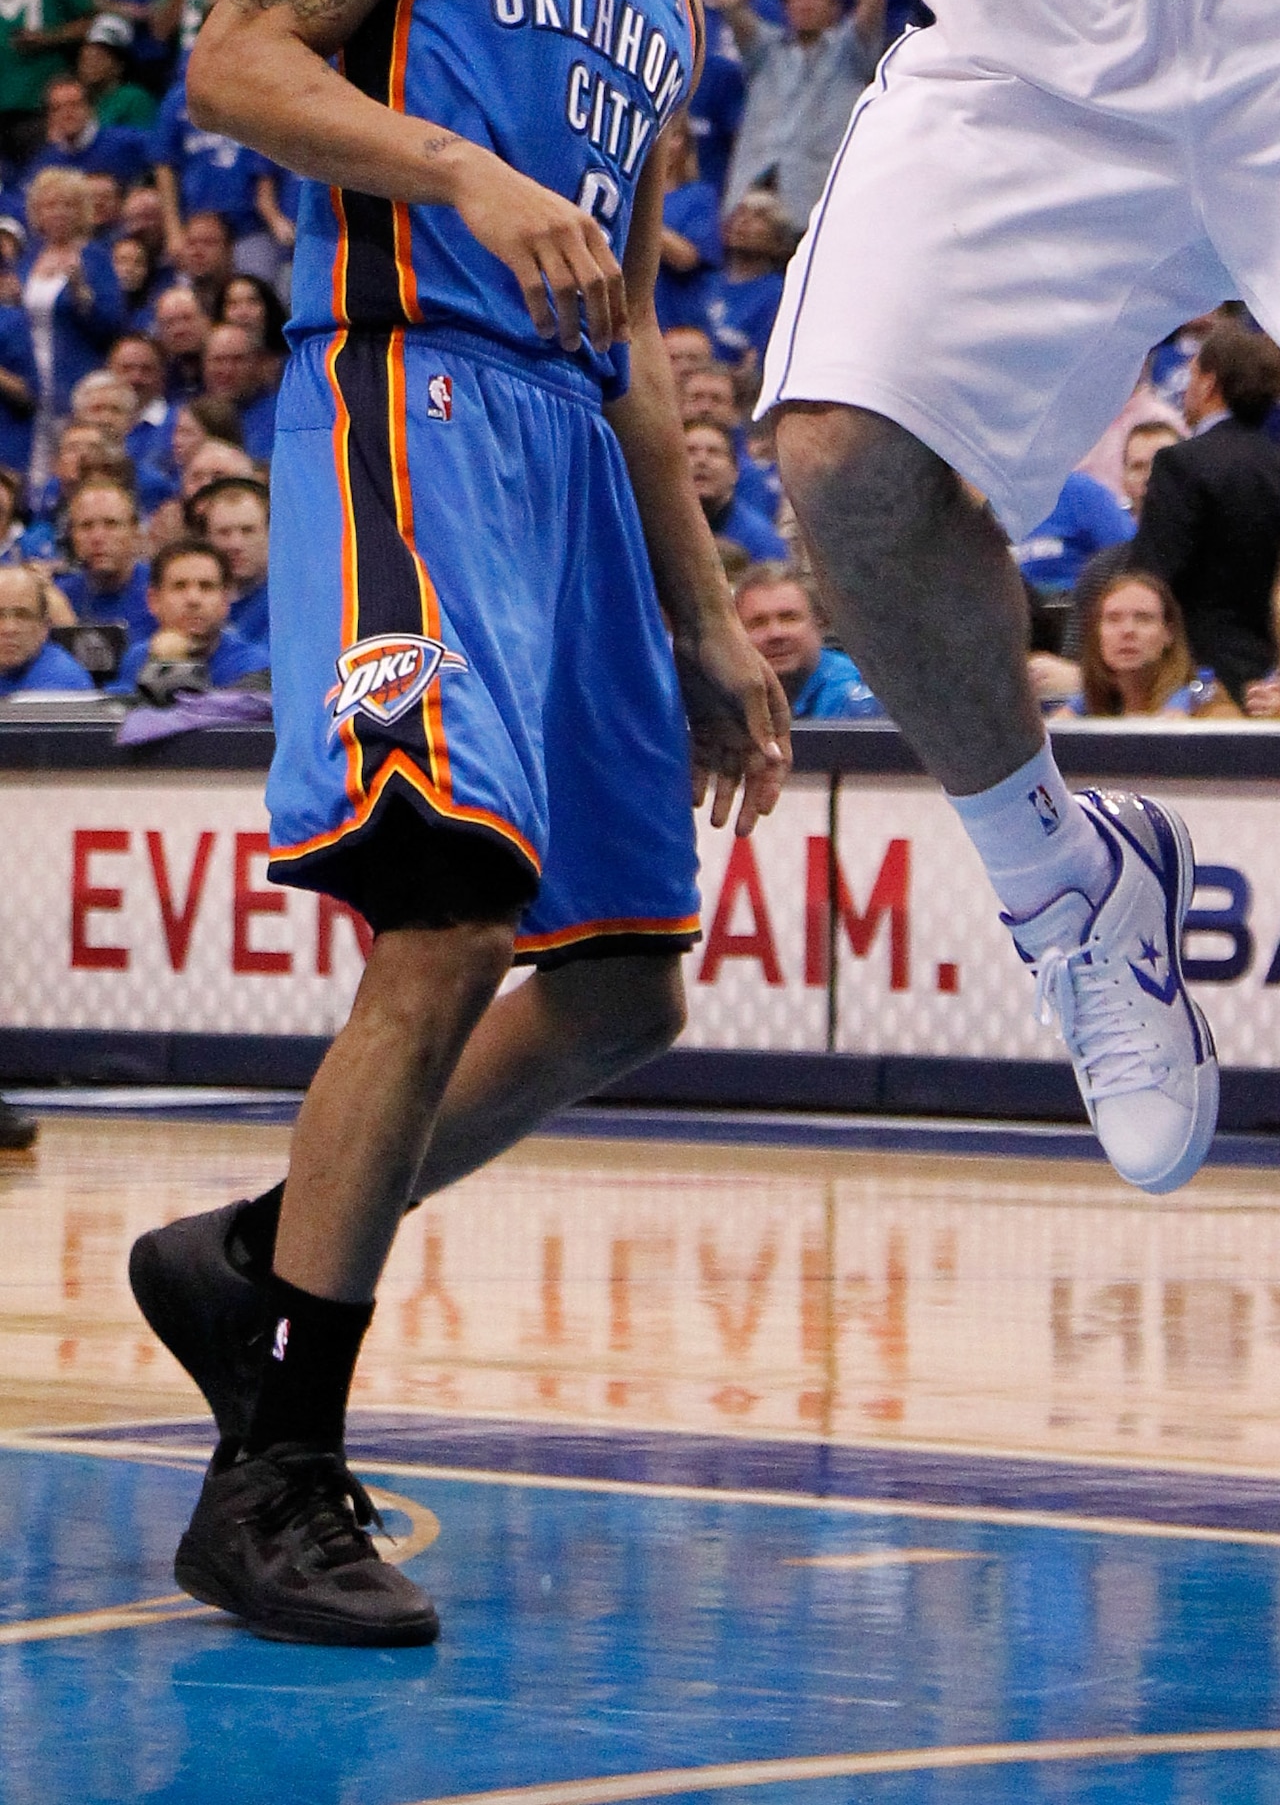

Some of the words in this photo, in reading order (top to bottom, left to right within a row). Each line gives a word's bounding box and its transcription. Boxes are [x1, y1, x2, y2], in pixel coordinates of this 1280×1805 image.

[567, 62, 652, 177] CITY
[334, 649, 420, 716] OKC
[698, 835, 959, 994] AM.
